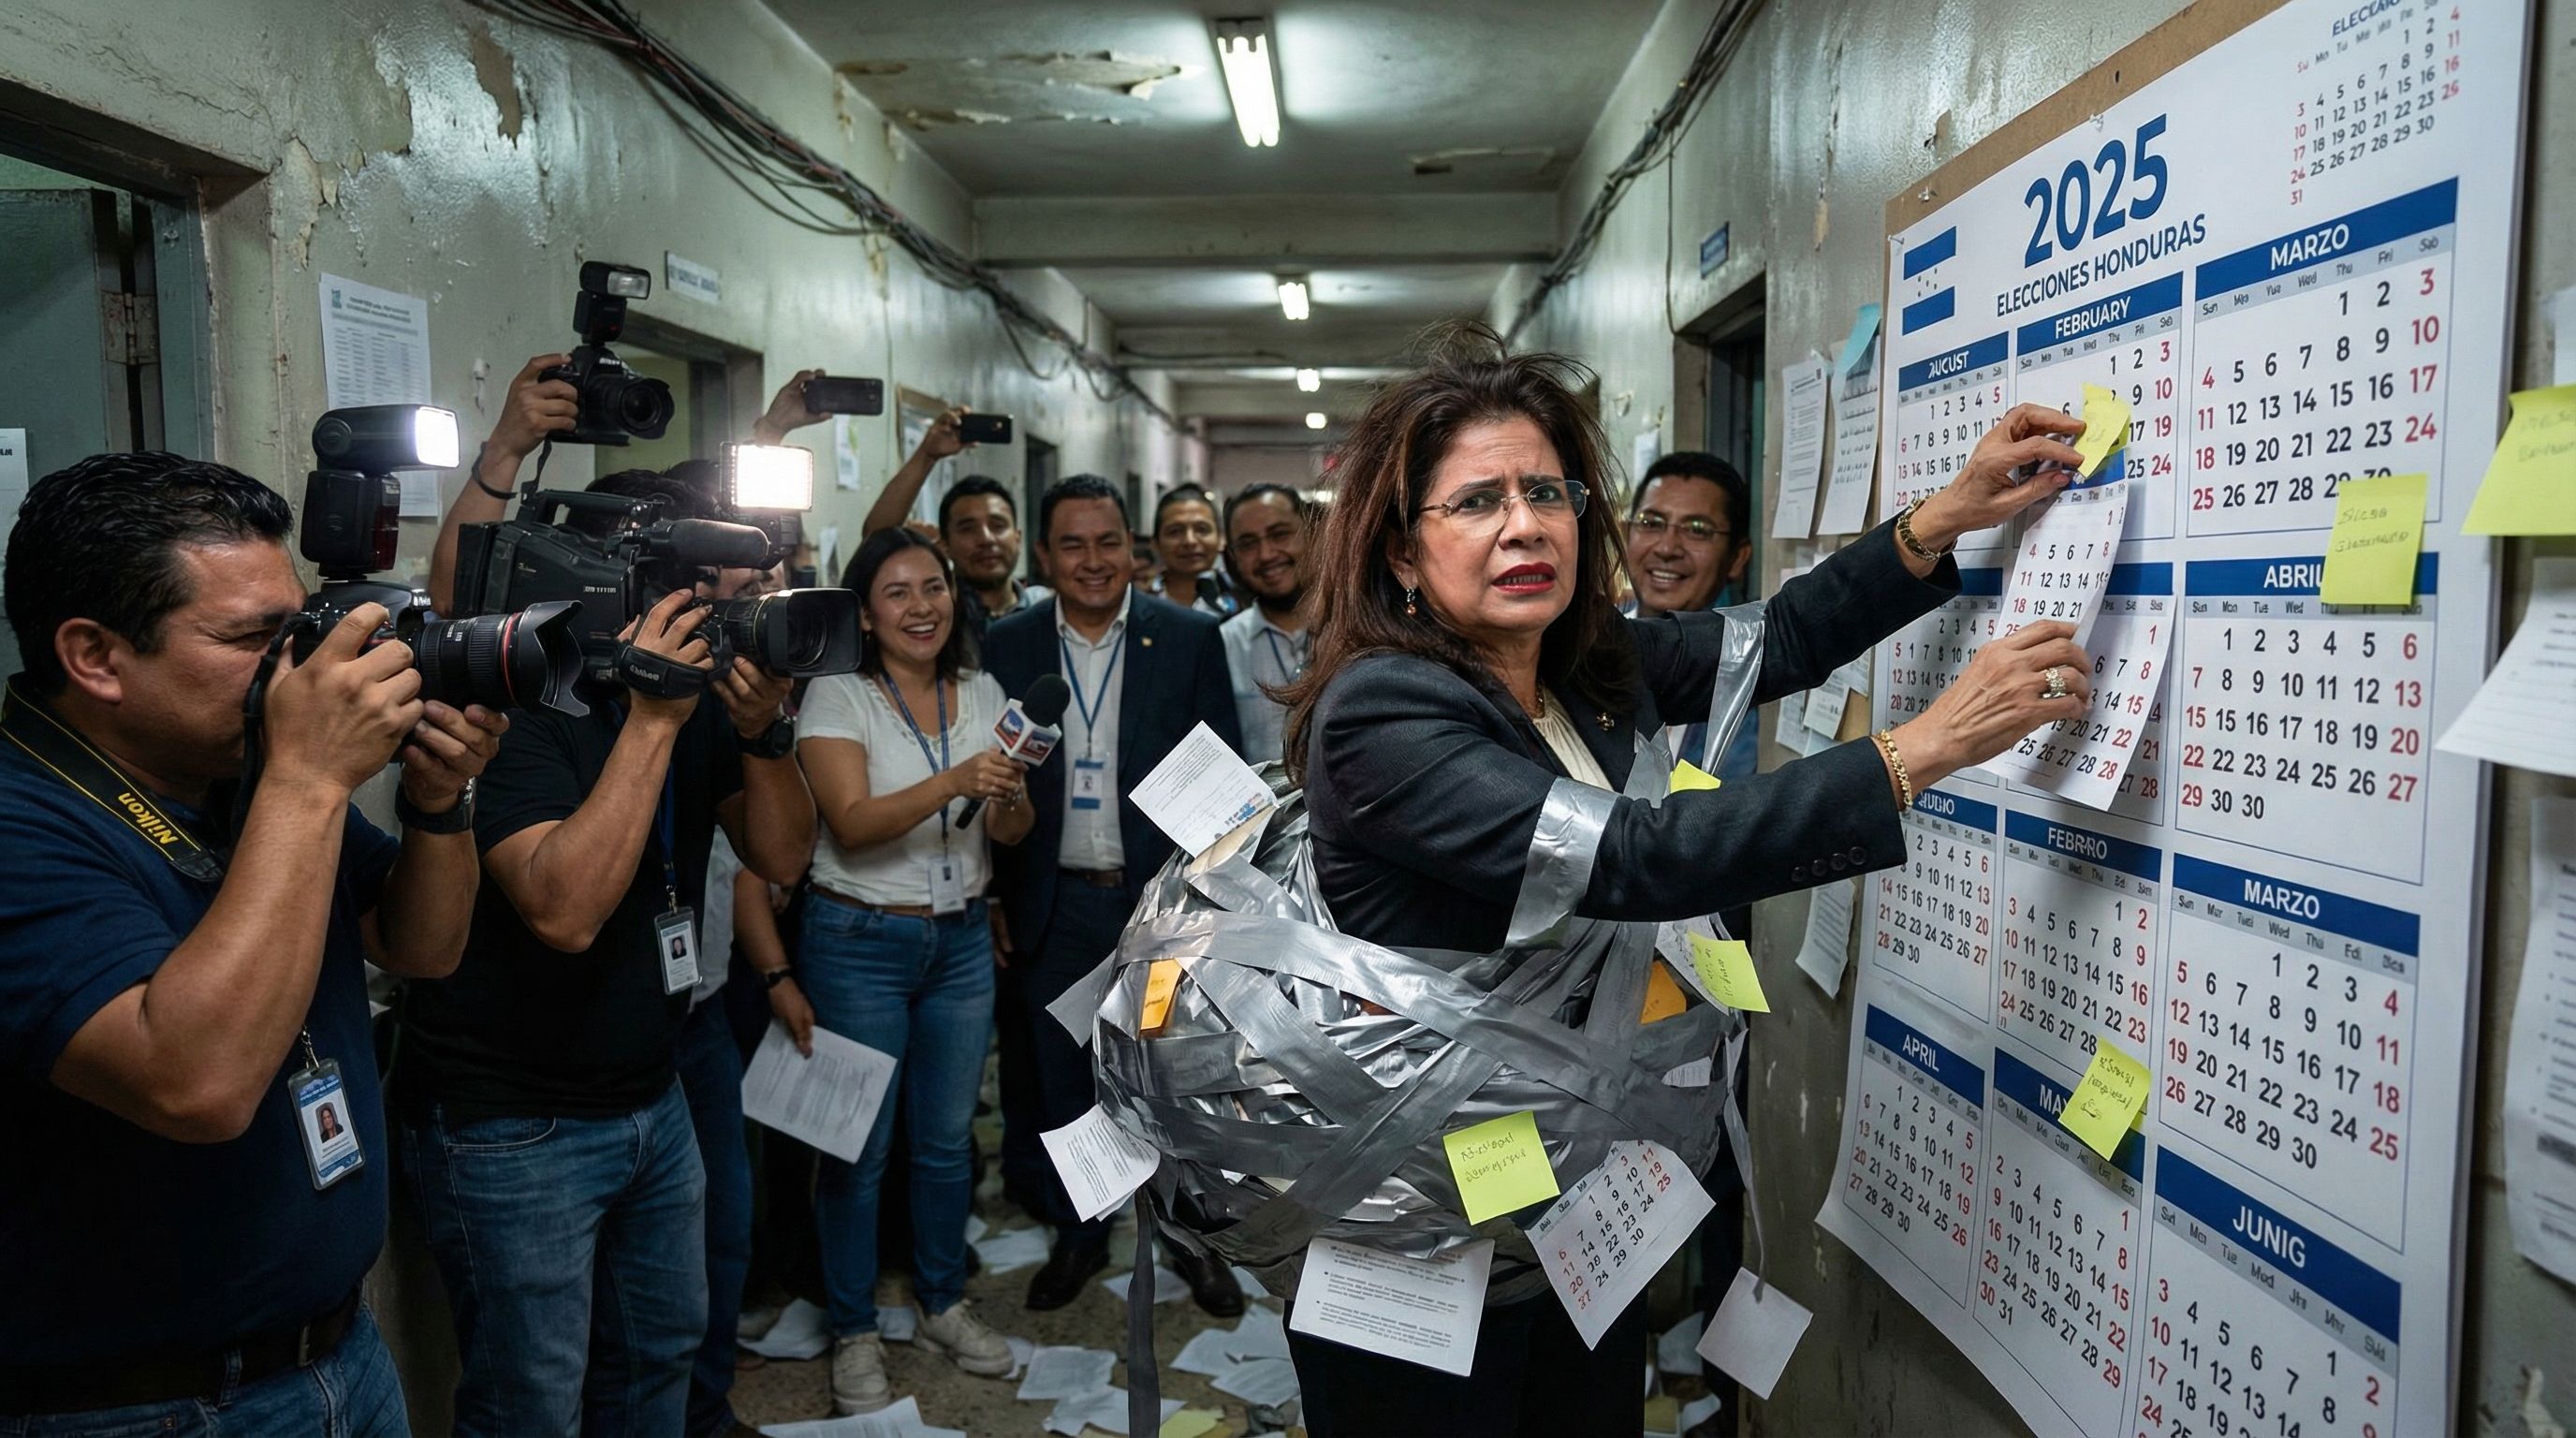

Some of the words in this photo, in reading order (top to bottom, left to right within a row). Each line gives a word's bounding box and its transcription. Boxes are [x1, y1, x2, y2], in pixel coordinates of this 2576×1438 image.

[2336, 84, 2344, 99] 5
[2357, 73, 2365, 90] 6
[2379, 64, 2388, 80] 7
[2401, 52, 2410, 69] 8
[2424, 43, 2434, 60] 9
[2449, 30, 2460, 49] 11
[2024, 113, 2168, 269] 2025
[1997, 260, 2089, 317] ELECCIONES
[2094, 213, 2206, 282] HONDURAS
[2270, 223, 2349, 271] MARZO
[2338, 290, 2348, 316] 1
[2377, 281, 2391, 307] 2
[2420, 268, 2434, 296] 3
[2055, 296, 2131, 340] FEBRUARY
[2110, 356, 2115, 374] 1
[2133, 348, 2144, 369] 2
[2160, 341, 2170, 362] 3
[2202, 367, 2215, 389] 4
[2233, 360, 2245, 383] 5
[2265, 352, 2276, 376] 6
[2299, 345, 2312, 369] 7
[2336, 335, 2349, 361] 8
[2376, 328, 2389, 354] 9
[2411, 315, 2439, 345] 10
[1930, 404, 1934, 419] 1
[1944, 401, 1951, 416] 2
[1960, 395, 1966, 412] 3
[1975, 391, 1983, 408] 4
[1994, 386, 1999, 404] 5
[1913, 434, 1921, 449] 7
[1928, 432, 1934, 448] 8
[1943, 429, 1949, 445] 9
[1956, 424, 1968, 442] 10
[1973, 420, 1983, 438] 11
[2048, 545, 2056, 560] 5
[2067, 545, 2074, 560] 6
[2086, 543, 2093, 560] 7
[1939, 618, 1945, 634] 2
[1954, 618, 1960, 635] 3
[1969, 620, 1977, 635] 4
[1988, 620, 1994, 638] 5
[2224, 627, 2232, 651] 1
[2254, 629, 2265, 652] 2
[2288, 629, 2299, 653] 3
[2323, 631, 2336, 655] 4
[2363, 631, 2376, 658] 5
[2404, 633, 2417, 660] 6
[2192, 667, 2203, 689] 7
[2222, 668, 2232, 691] 8
[2252, 670, 2263, 693] 9
[2280, 672, 2304, 697] 10
[2316, 674, 2336, 700] 11
[2353, 677, 2379, 704] 12
[2394, 680, 2422, 708] 13
[2070, 719, 2089, 738] 20
[2090, 724, 2110, 743] 21
[2112, 728, 2132, 748] 22
[2018, 738, 2037, 756] 25
[2037, 743, 2056, 762] 26
[2056, 749, 2076, 768] 27
[2076, 755, 2097, 774] 28
[2098, 760, 2118, 780] 28
[1917, 834, 1923, 851] 2
[1932, 839, 1938, 856] 3
[1947, 846, 1954, 861] 4
[1964, 850, 1971, 867] 5
[1981, 856, 1988, 873] 6
[2115, 901, 2121, 921] 1
[2138, 908, 2147, 931] 2
[2244, 879, 2320, 920] MARZO
[2009, 897, 2016, 916] 3
[2027, 904, 2035, 923] 4
[2048, 912, 2056, 931] 5
[2069, 919, 2076, 940] 6
[2091, 927, 2099, 947] 7
[2114, 936, 2121, 957] 8
[2136, 946, 2145, 966] 9
[2273, 953, 2280, 977] 1
[2306, 963, 2320, 990] 2
[2344, 976, 2357, 1002] 3
[2383, 989, 2398, 1017] 4
[2177, 961, 2187, 983] 5
[2205, 972, 2217, 995] 6
[2237, 981, 2248, 1005] 7
[2269, 994, 2280, 1020] 8
[2305, 1007, 2317, 1034] 9
[2336, 1020, 2362, 1050] 10
[2376, 1034, 2398, 1065] 11
[1902, 1034, 1939, 1073] APRIL
[1897, 1086, 1902, 1102] 1
[1911, 1095, 1919, 1113] 2
[1928, 1107, 1936, 1123] 3
[1947, 1120, 1953, 1137] 4
[1966, 1131, 1973, 1150] 5
[2039, 1084, 2068, 1117] MA
[1588, 1195, 1596, 1205] 1
[1604, 1175, 1612, 1188] 2
[1620, 1155, 1629, 1167] 3
[1874, 1130, 1884, 1150] 14
[1889, 1141, 1901, 1161] 15
[1905, 1153, 1917, 1174] 16
[1921, 1166, 1934, 1186] 17
[1939, 1180, 1951, 1201] 18
[1956, 1193, 1969, 1215] 19
[1559, 1250, 1566, 1260] 6
[1577, 1230, 1584, 1241] 7
[1596, 1211, 1603, 1221] 8
[1612, 1190, 1619, 1201] 9
[1626, 1167, 1638, 1182] 10
[1642, 1148, 1654, 1164] 11
[1996, 1155, 2003, 1174] 2
[2014, 1168, 2022, 1187] 3
[2033, 1183, 2041, 1204] 4
[2054, 1198, 2062, 1219] 5
[2074, 1213, 2083, 1236] 6
[2097, 1229, 2105, 1251] 7
[2117, 1247, 2127, 1269] 8
[2121, 1210, 2129, 1232] 1
[2232, 1206, 2305, 1269] JUNIG
[2159, 1279, 2168, 1302] 3
[2187, 1301, 2198, 1324] 4
[2218, 1320, 2230, 1346] 5
[2250, 1344, 2263, 1371] 6
[2286, 1367, 2299, 1395] 7
[2321, 1396, 2336, 1425] 8
[2327, 1350, 2336, 1376] 1
[2364, 1376, 2379, 1406] 2
